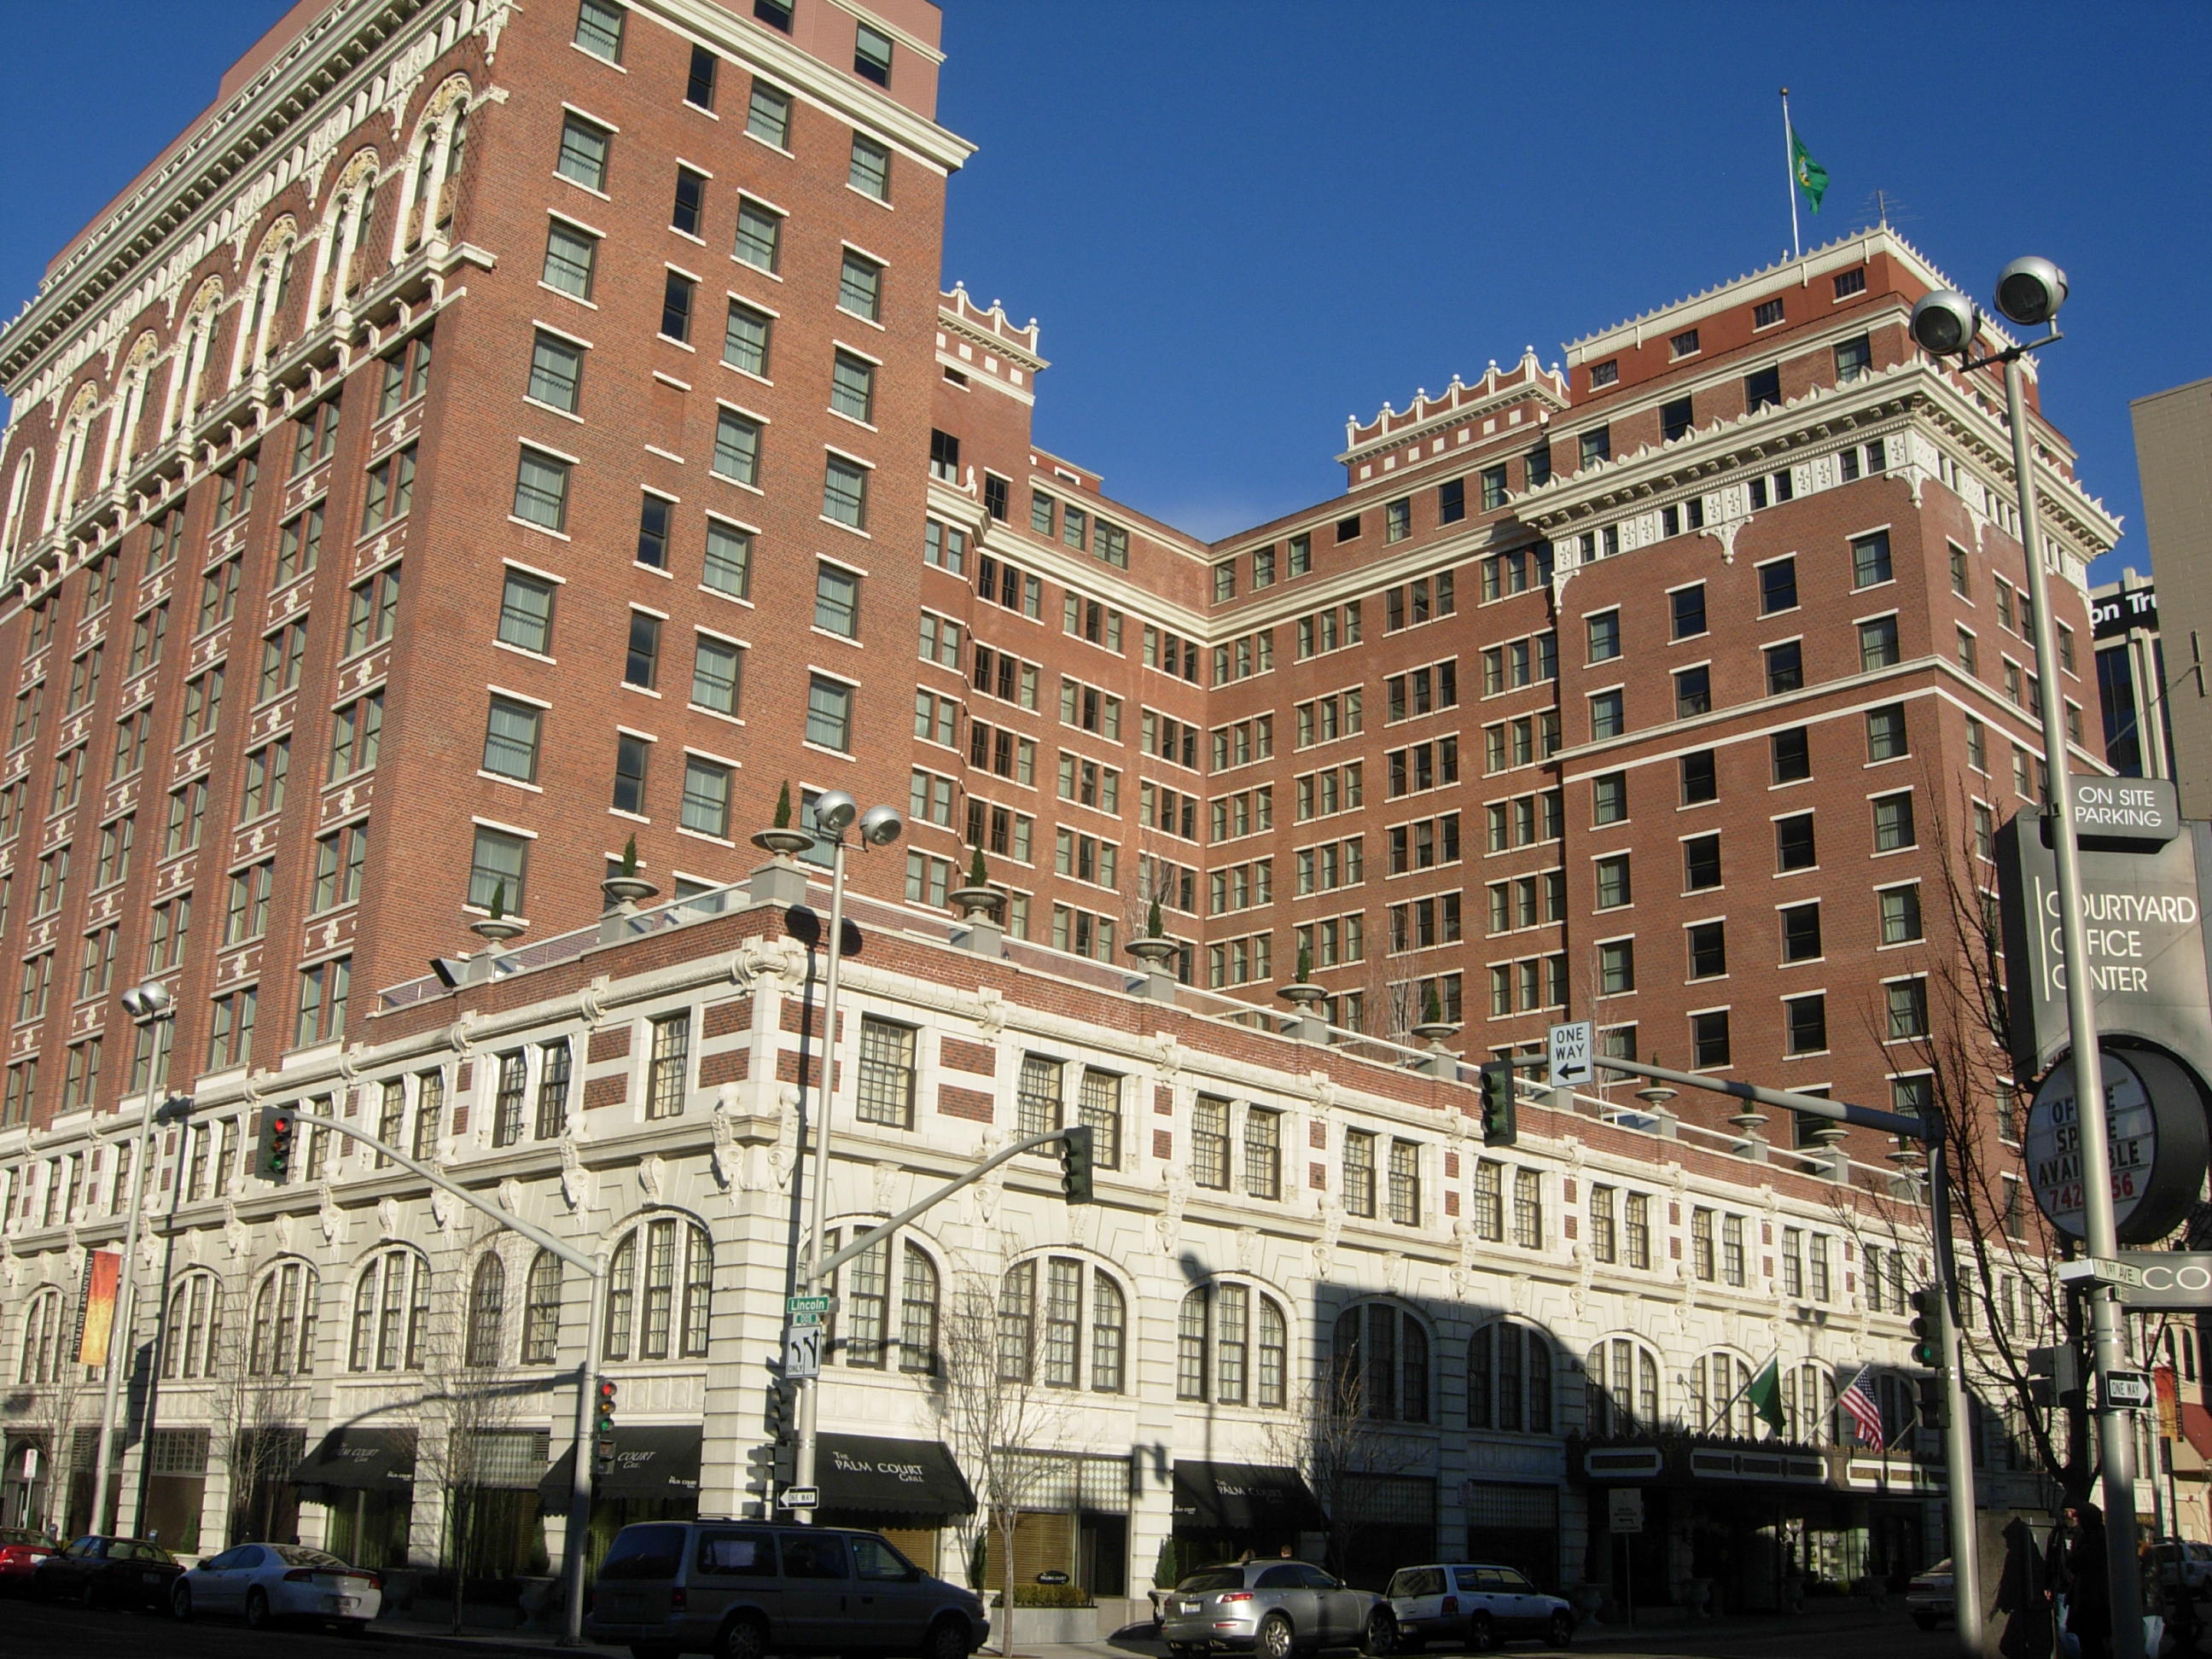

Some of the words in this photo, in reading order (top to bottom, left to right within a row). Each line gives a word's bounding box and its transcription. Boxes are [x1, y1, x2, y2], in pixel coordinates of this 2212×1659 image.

[2078, 786, 2113, 805] ON
[2119, 788, 2156, 807] SITE
[2075, 806, 2162, 827] PARKING
[2052, 963, 2148, 992] CNTER
[1556, 1027, 1584, 1044] ONE
[1555, 1043, 1585, 1061] WAY
[2052, 1086, 2116, 1124] OFE
[2056, 1116, 2117, 1153] SPE
[2119, 1266, 2135, 1283] AVE
[2141, 1266, 2212, 1291] CO
[790, 1298, 825, 1312] Lincoln
[73, 1312, 85, 1355] DISTRICT
[788, 1365, 803, 1373] ONLY
[2111, 1381, 2125, 1396] ONE
[2126, 1382, 2139, 1397] WAY
[617, 1452, 656, 1462] COURT
[834, 1459, 872, 1472] PALM
[877, 1463, 924, 1476] COURT
[788, 1493, 799, 1502] ONE
[801, 1493, 813, 1502] WAY
[1216, 1485, 1246, 1496] PALM
